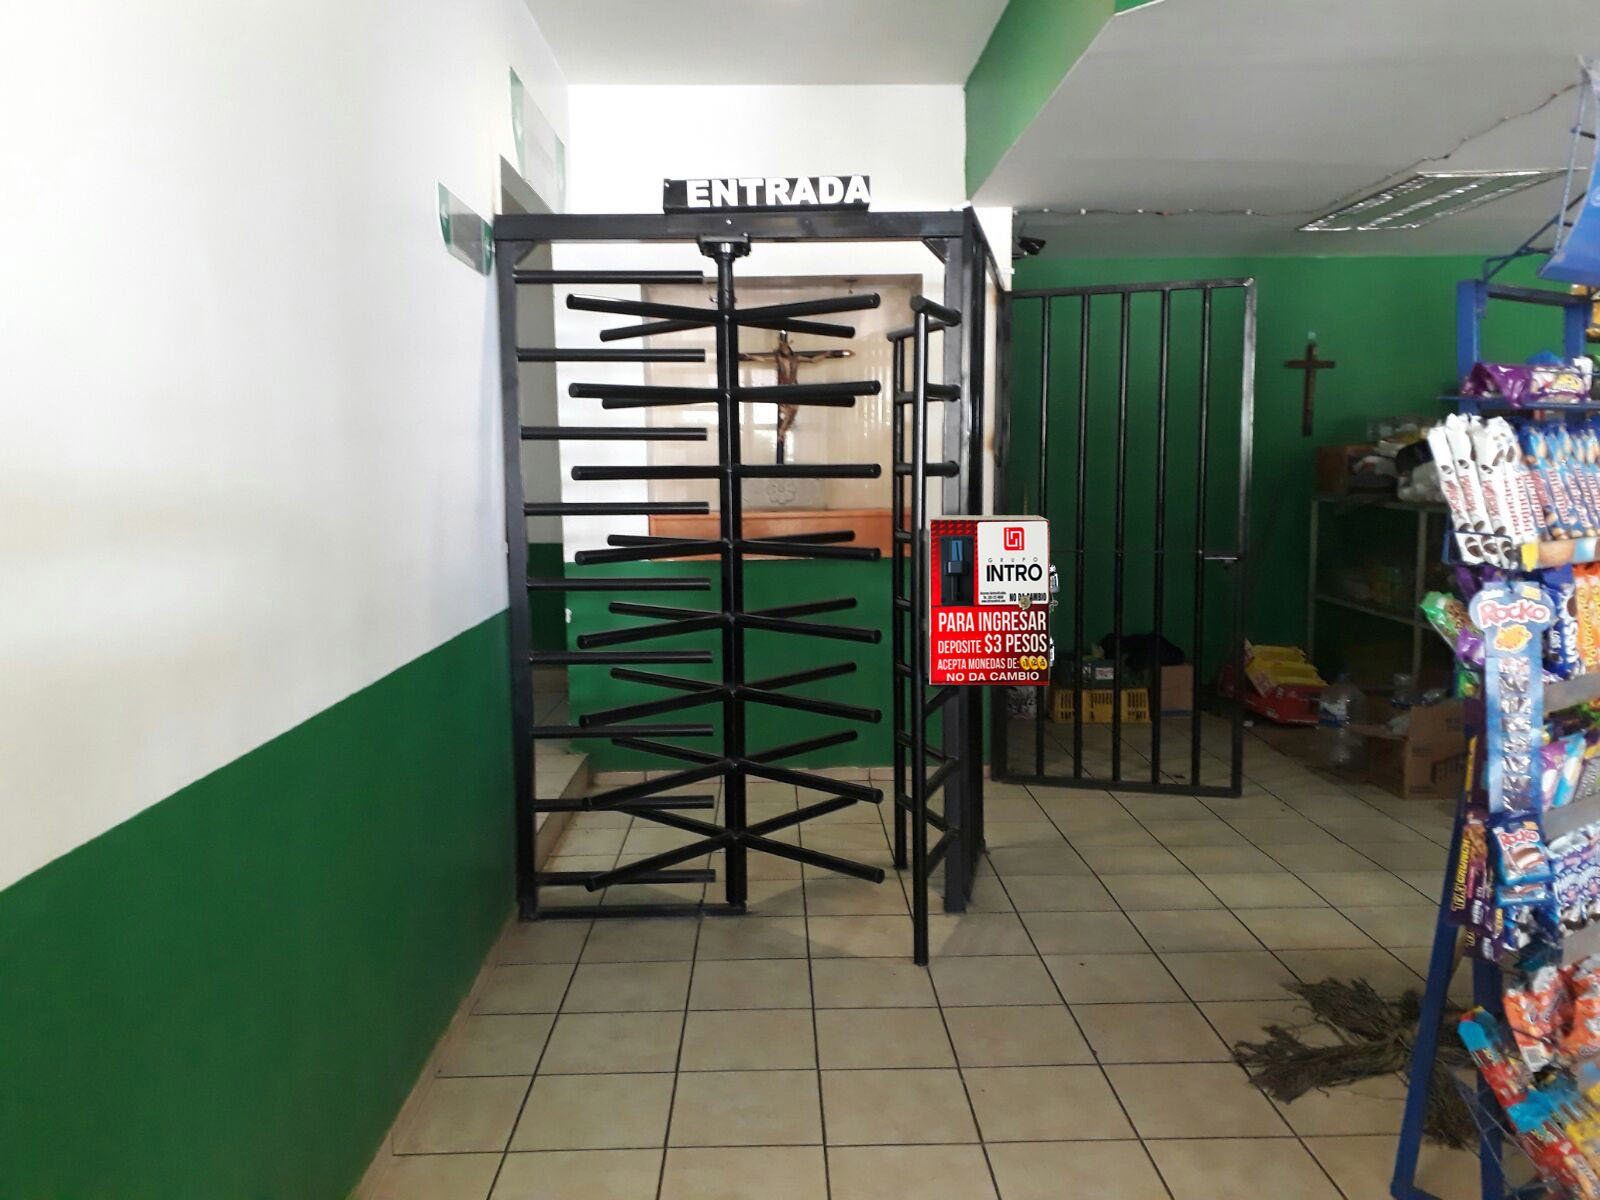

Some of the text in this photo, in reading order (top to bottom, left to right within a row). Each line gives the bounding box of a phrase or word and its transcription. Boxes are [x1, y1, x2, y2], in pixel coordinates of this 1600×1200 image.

[686, 175, 871, 208] ENTRADA
[987, 563, 1043, 582] INTRO
[1009, 592, 1017, 602] NO
[938, 611, 1047, 632] PARA INGRESAR
[937, 633, 1048, 654] DEPOSITE $3 PESOS
[937, 658, 967, 671] ACEPTA
[968, 657, 1006, 670] MONEDAS
[1007, 657, 1020, 669] DE:
[946, 671, 1040, 682] NO DA CAMBIO
